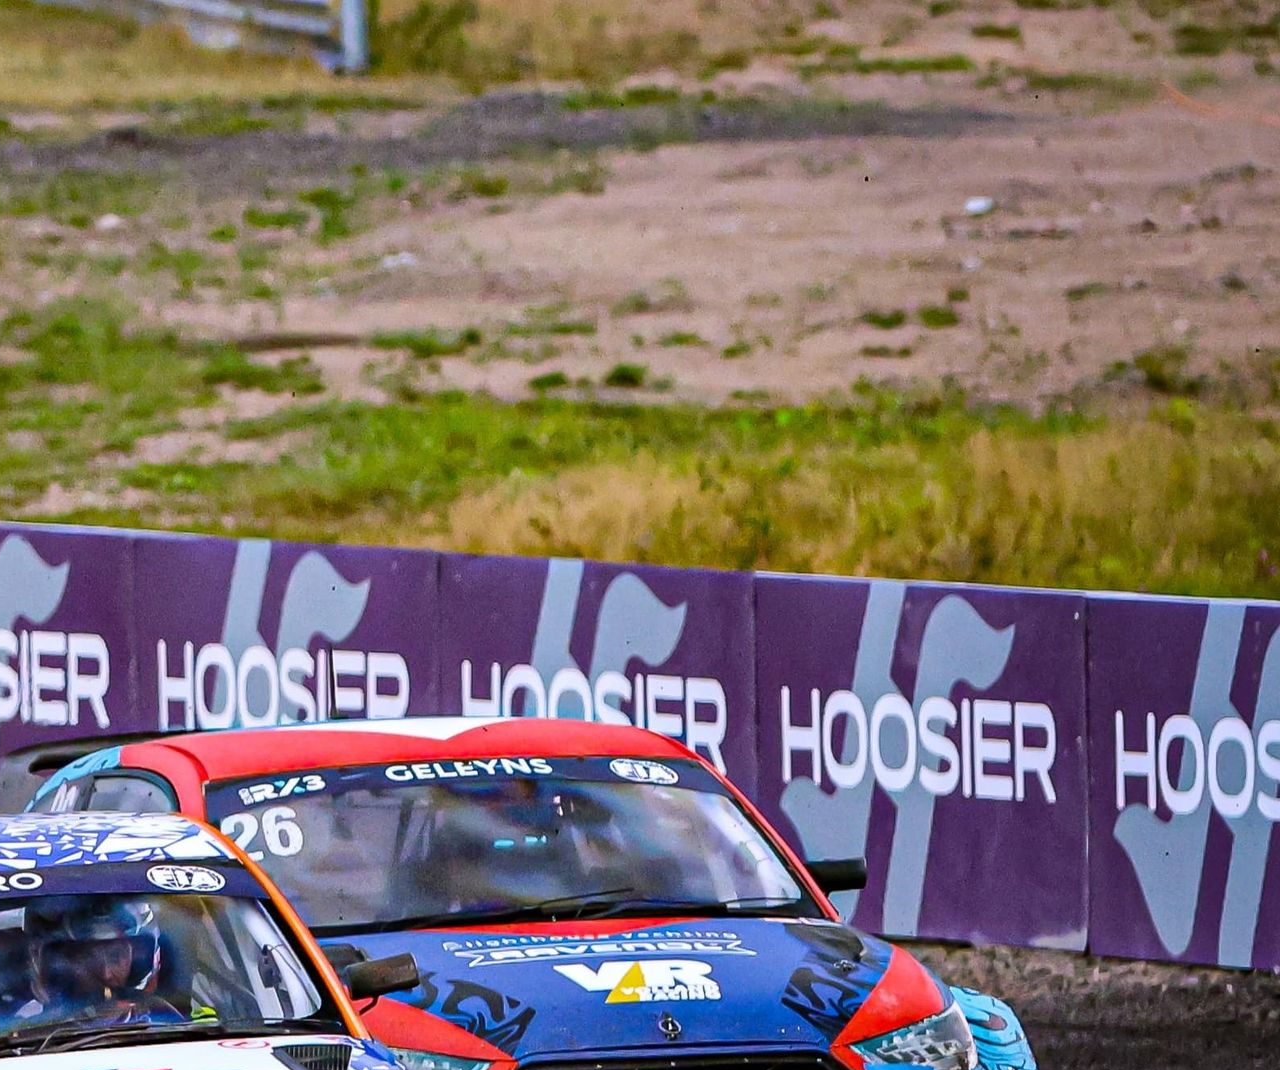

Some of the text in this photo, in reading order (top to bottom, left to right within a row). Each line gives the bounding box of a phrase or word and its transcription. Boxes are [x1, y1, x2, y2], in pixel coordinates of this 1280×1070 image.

[385, 757, 553, 783] GELEYNS
[780, 685, 1058, 804] HOOSIER
[220, 806, 304, 862] 26
